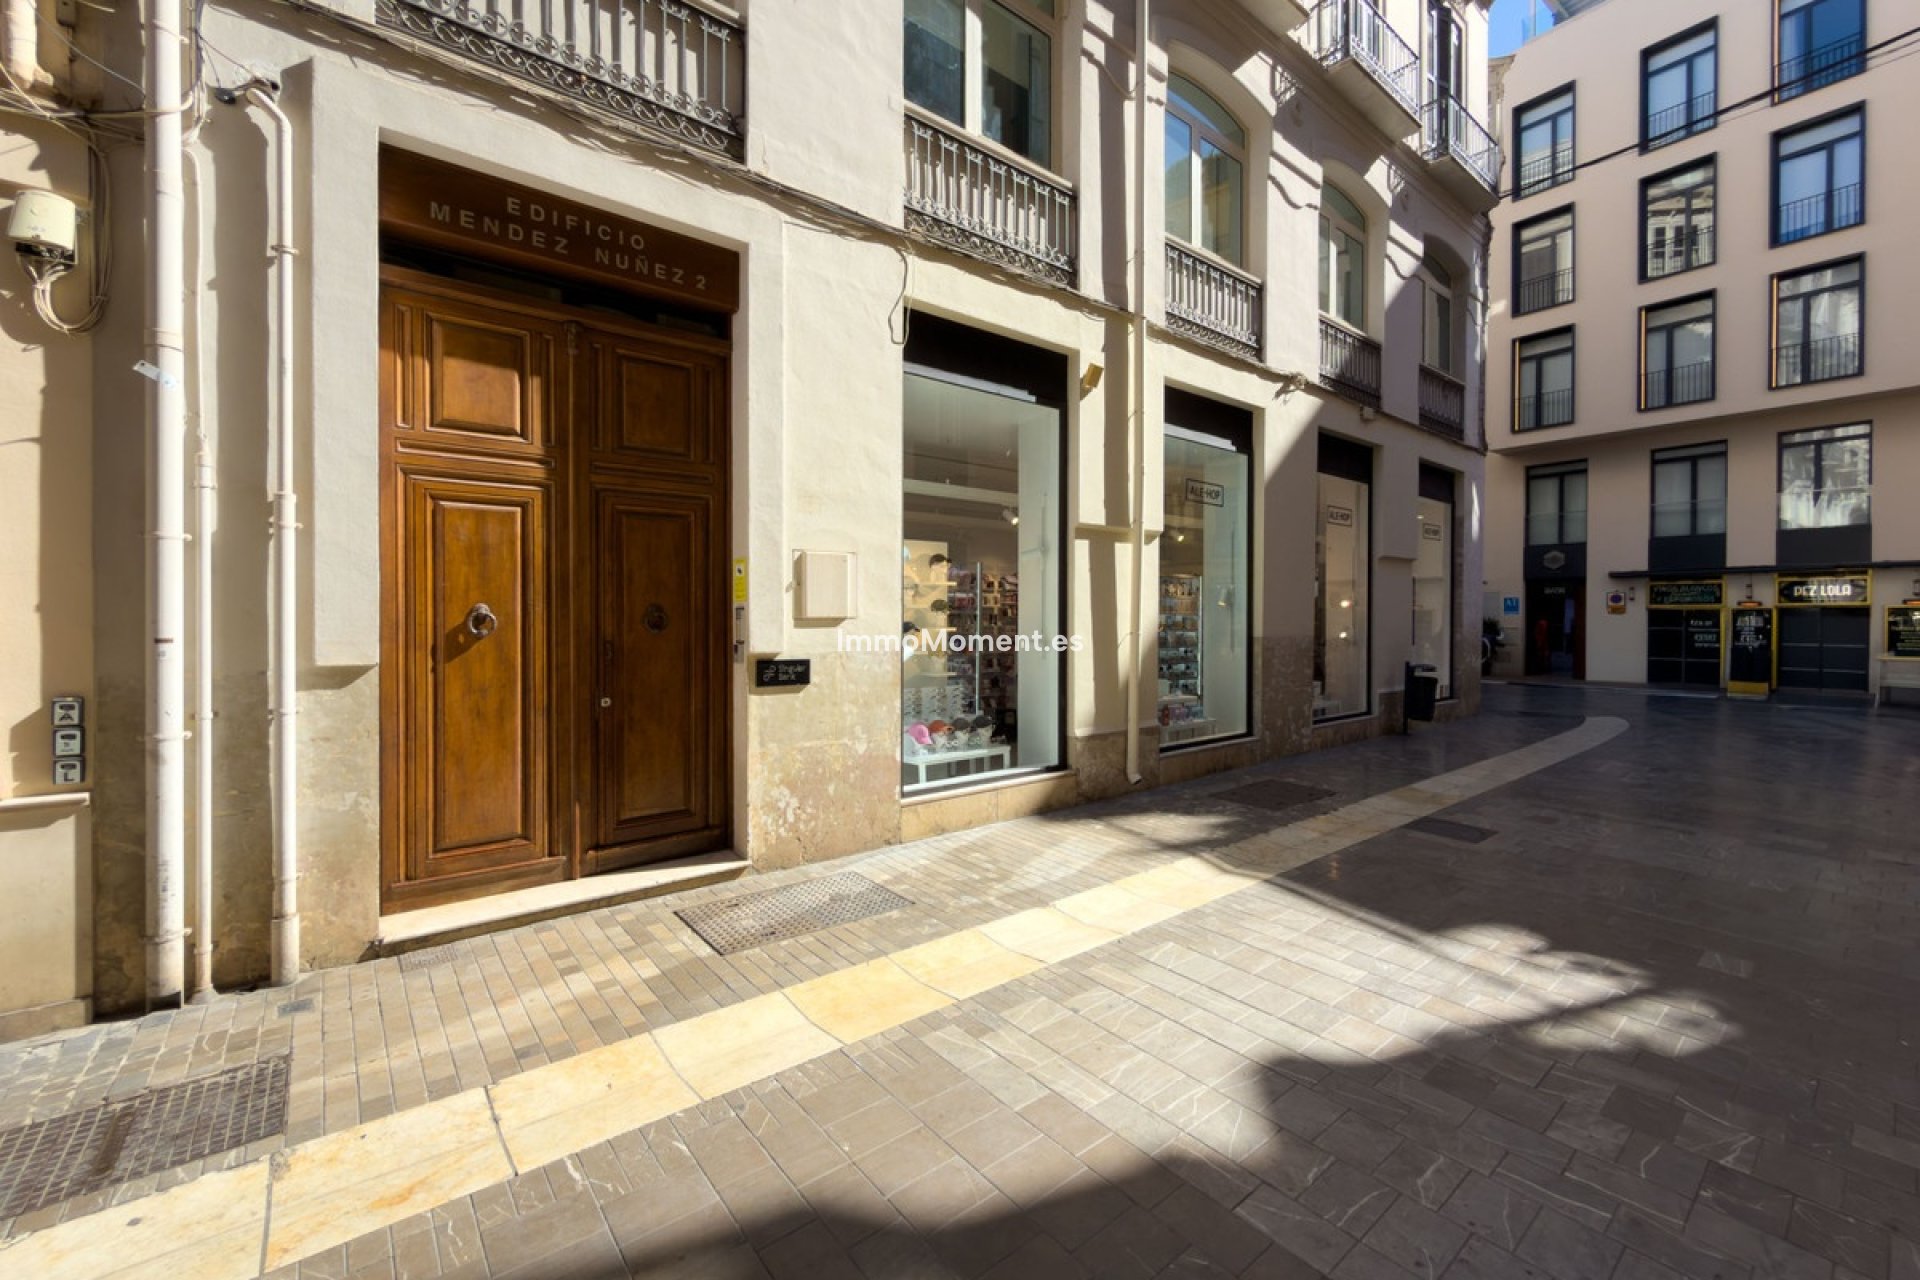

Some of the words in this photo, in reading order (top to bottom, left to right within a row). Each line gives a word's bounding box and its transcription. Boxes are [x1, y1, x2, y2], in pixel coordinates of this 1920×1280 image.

[506, 197, 645, 250] EDIFICIO
[430, 201, 569, 254] MENDEZ
[594, 247, 685, 285] NUÑEZ
[695, 275, 706, 290] 2
[1189, 485, 1221, 501] ALE-HOP
[1820, 584, 1852, 596] LOLA
